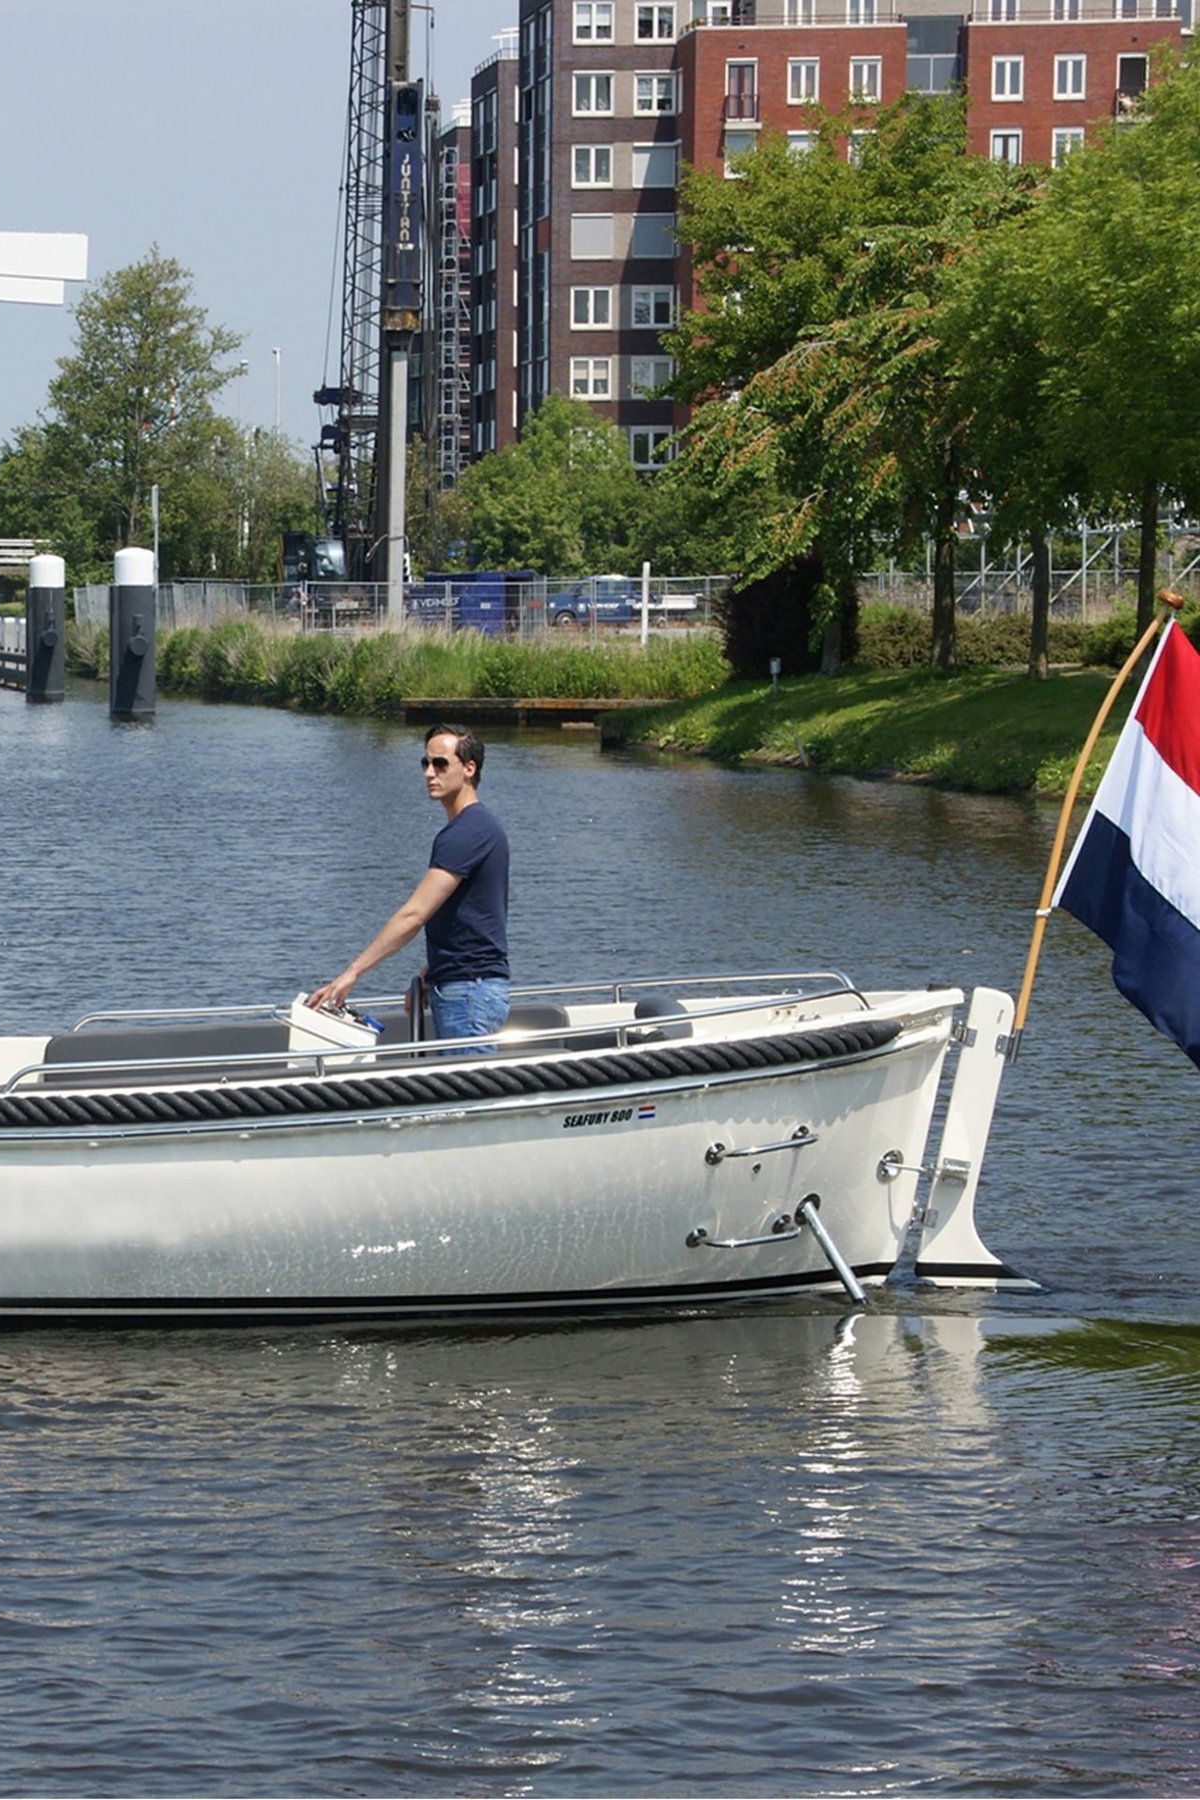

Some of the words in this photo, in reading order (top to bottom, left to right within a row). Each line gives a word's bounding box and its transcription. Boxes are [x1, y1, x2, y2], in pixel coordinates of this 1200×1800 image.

[400, 153, 411, 241] JUNTTAN
[563, 1112, 610, 1128] SEAFURY
[610, 1108, 633, 1123] 800
